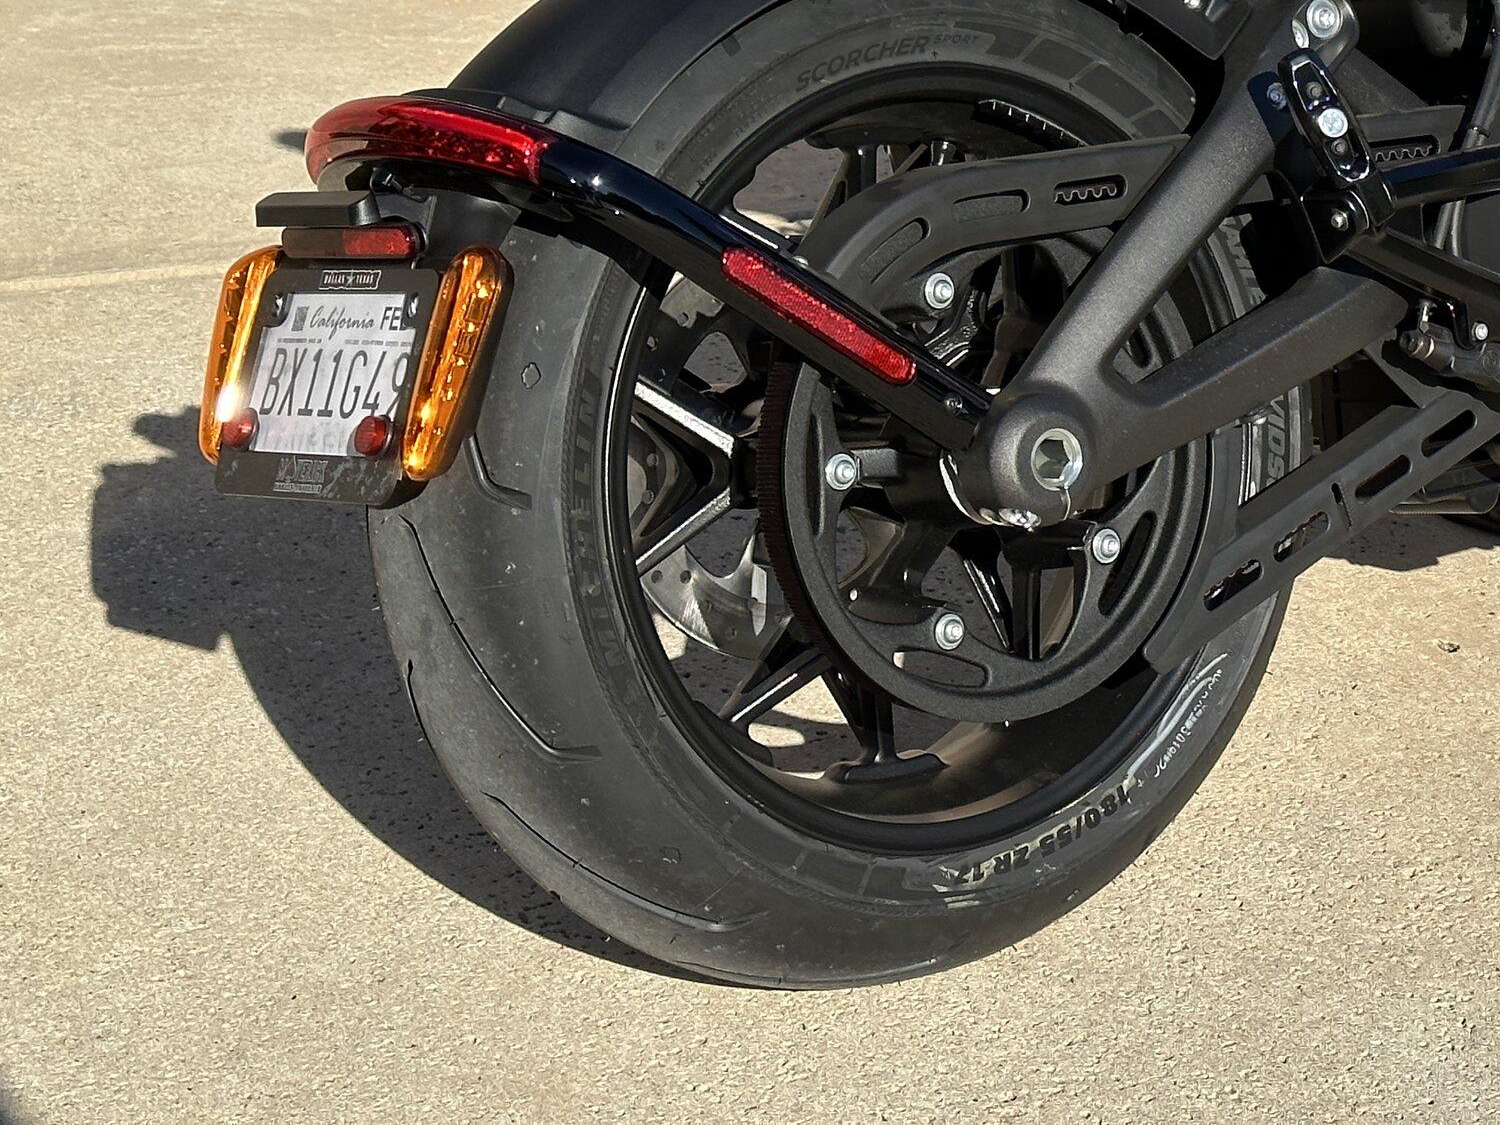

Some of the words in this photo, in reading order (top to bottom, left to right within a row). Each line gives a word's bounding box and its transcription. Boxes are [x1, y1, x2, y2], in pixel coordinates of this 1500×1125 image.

[796, 34, 930, 92] SCORCHER
[934, 33, 980, 45] SPORT
[309, 305, 375, 341] California
[259, 347, 410, 419] BX11G49
[571, 386, 626, 669] MICHELIN
[1040, 784, 1132, 857] 180/55
[993, 845, 1031, 876] ZR
